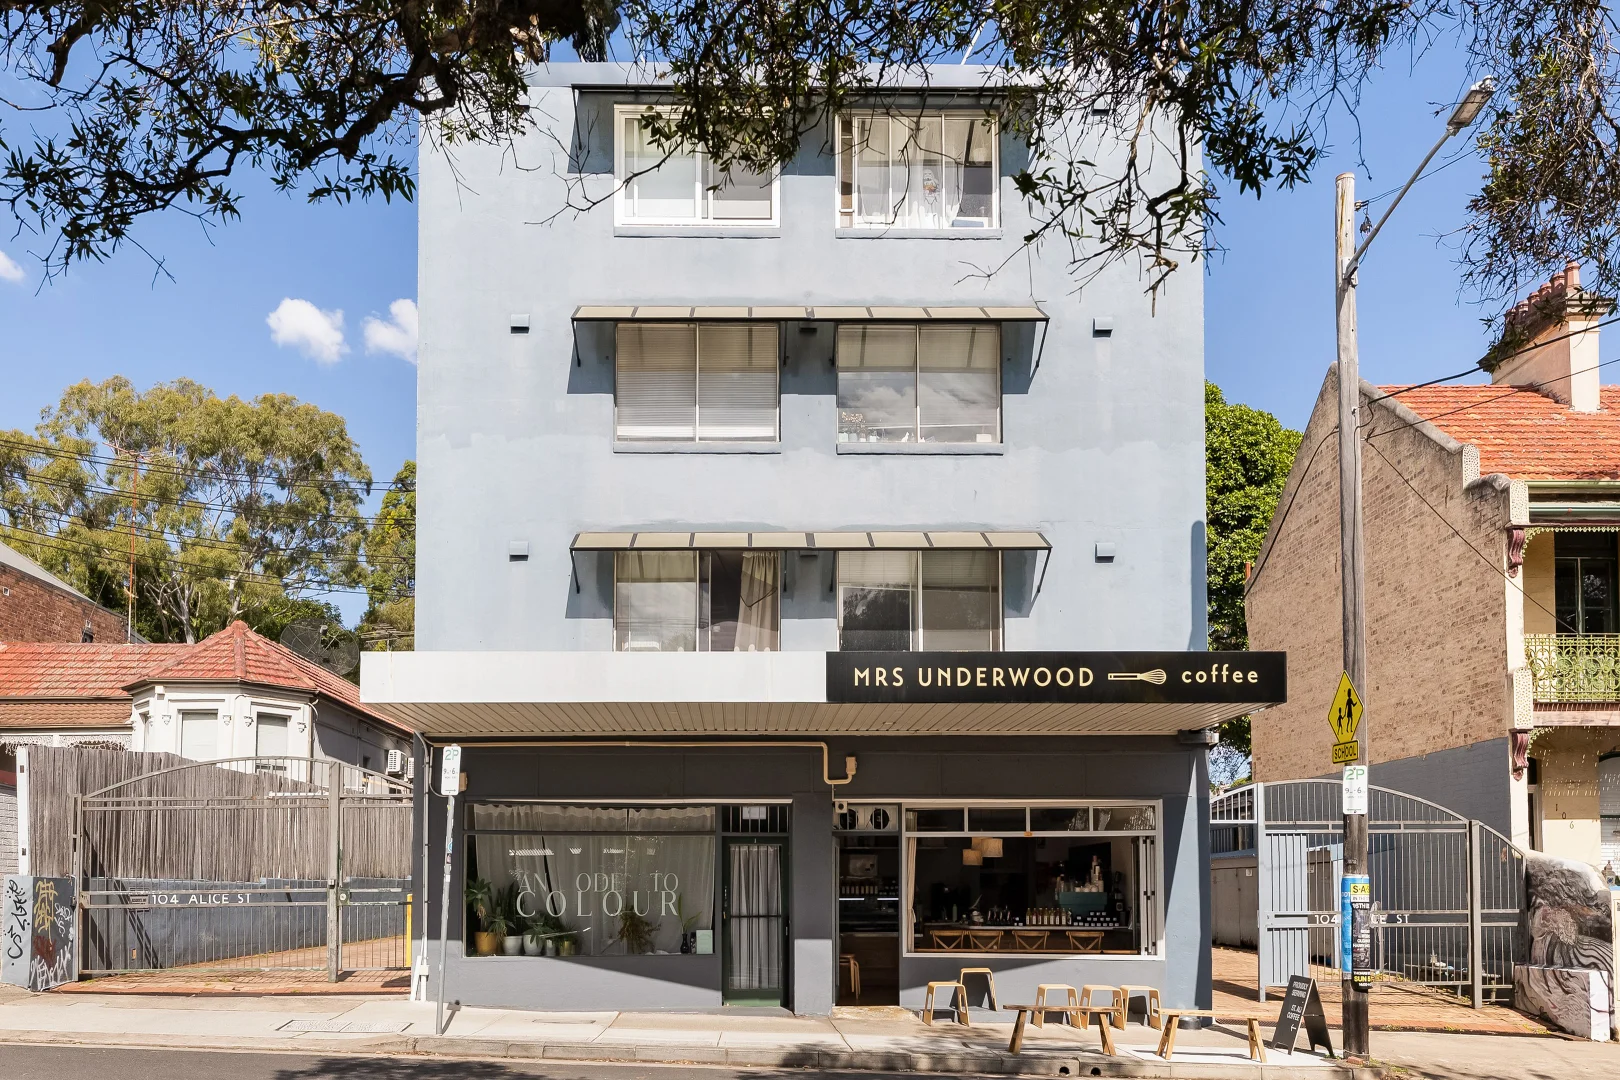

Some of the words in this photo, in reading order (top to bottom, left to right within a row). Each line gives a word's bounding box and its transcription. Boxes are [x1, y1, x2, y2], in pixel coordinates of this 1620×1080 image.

[855, 667, 904, 687] MRS
[919, 667, 1094, 687] UNDERWOOD
[1181, 663, 1259, 684] coffee
[445, 749, 459, 761] 2P
[1334, 745, 1356, 760] SCHOOL
[1345, 768, 1365, 780] 2P
[518, 872, 548, 892] AN
[576, 872, 623, 892] ODE
[650, 872, 679, 892] TO
[152, 893, 179, 905] 104
[188, 893, 229, 905] ALICE
[237, 893, 252, 905] ST
[516, 890, 679, 917] COLOUR
[1314, 914, 1338, 925] 104
[1396, 914, 1410, 925] ST
[1286, 1011, 1301, 1021] COFFEE
